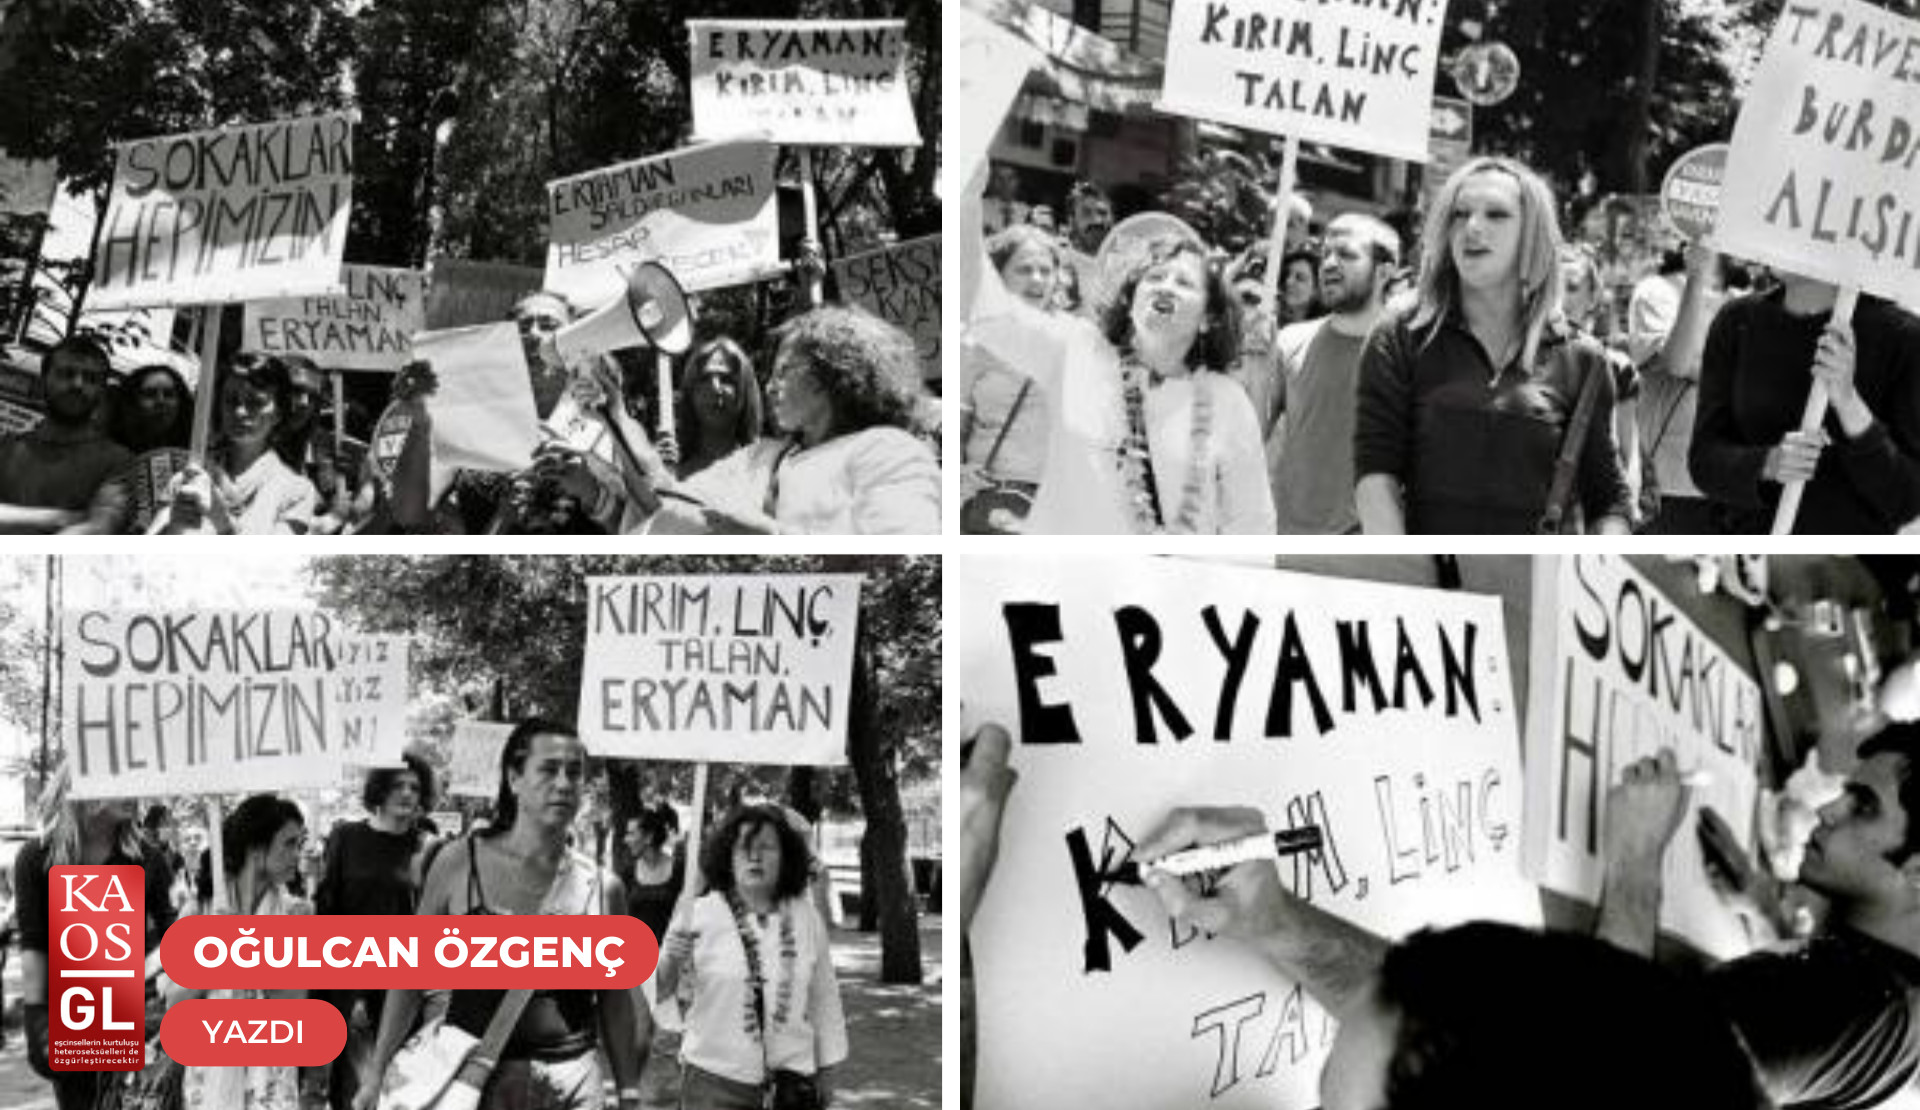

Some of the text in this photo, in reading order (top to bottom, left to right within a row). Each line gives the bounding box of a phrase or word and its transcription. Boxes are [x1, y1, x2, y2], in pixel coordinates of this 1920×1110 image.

[708, 29, 897, 59] ERYAMAN:
[1235, 71, 1367, 123] TALAN
[125, 116, 353, 198] SOKAKLAR
[259, 317, 413, 353] ERYAMAN
[78, 610, 337, 678] SOKAKLAR
[1001, 601, 1503, 744] ERYAMAN:
[601, 676, 832, 732] ERYAMAN
[1190, 981, 1330, 1098] TA
